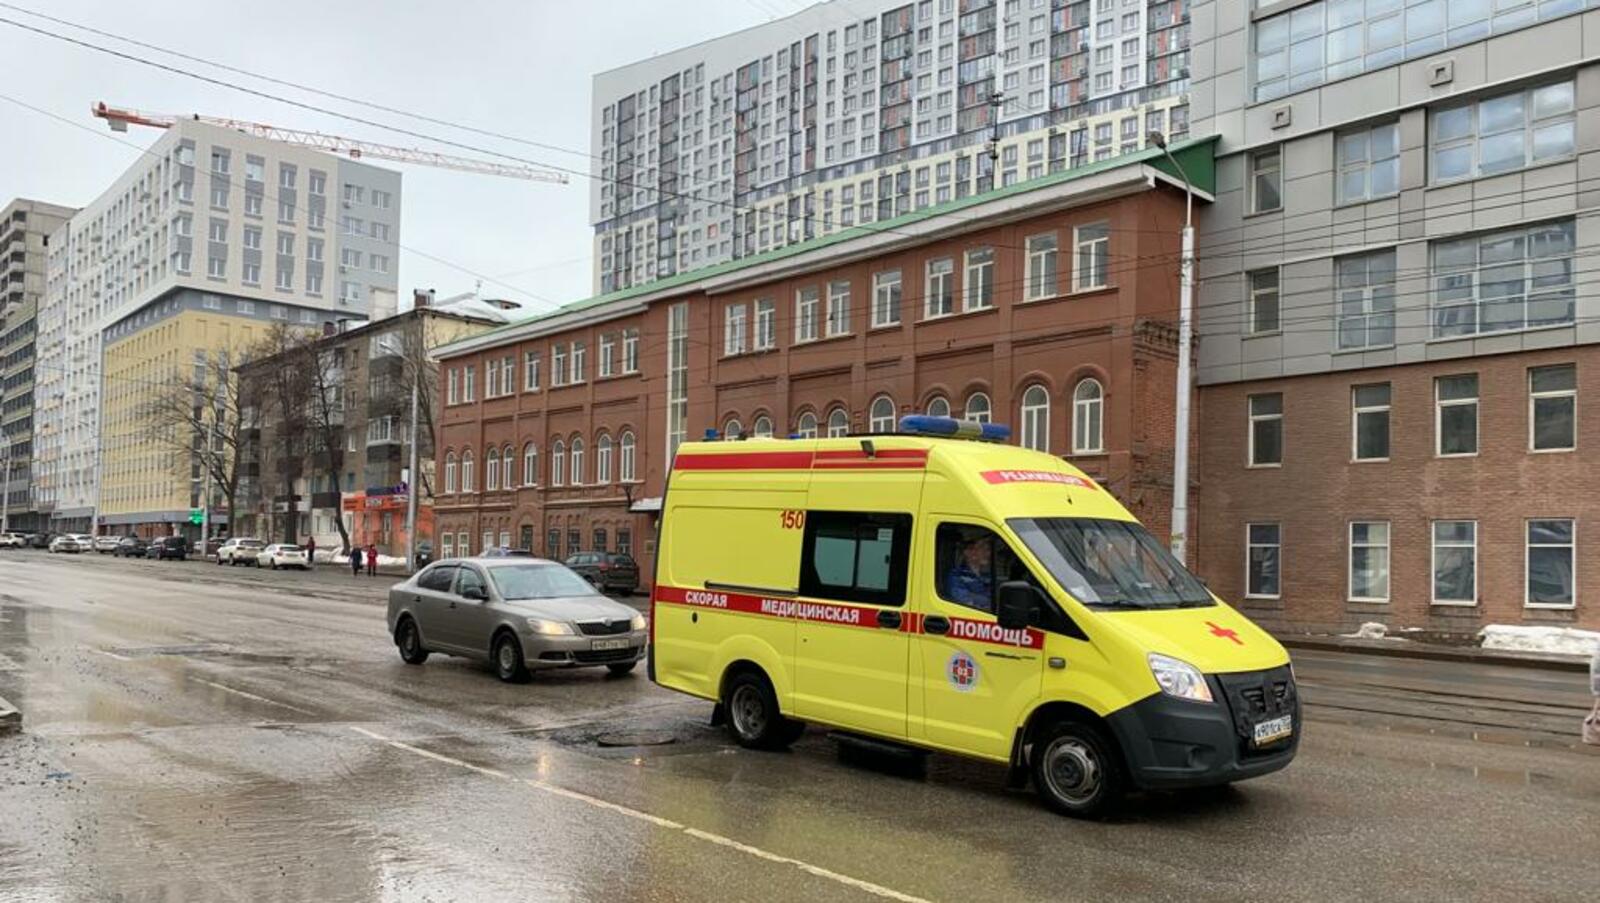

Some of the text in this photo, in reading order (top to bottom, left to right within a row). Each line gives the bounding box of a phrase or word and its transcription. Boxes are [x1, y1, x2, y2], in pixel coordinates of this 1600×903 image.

[780, 511, 804, 529] 150
[685, 591, 1033, 646] СКОРАЯ МЕДИЦИНСКАЯ ПОМОЩЬ
